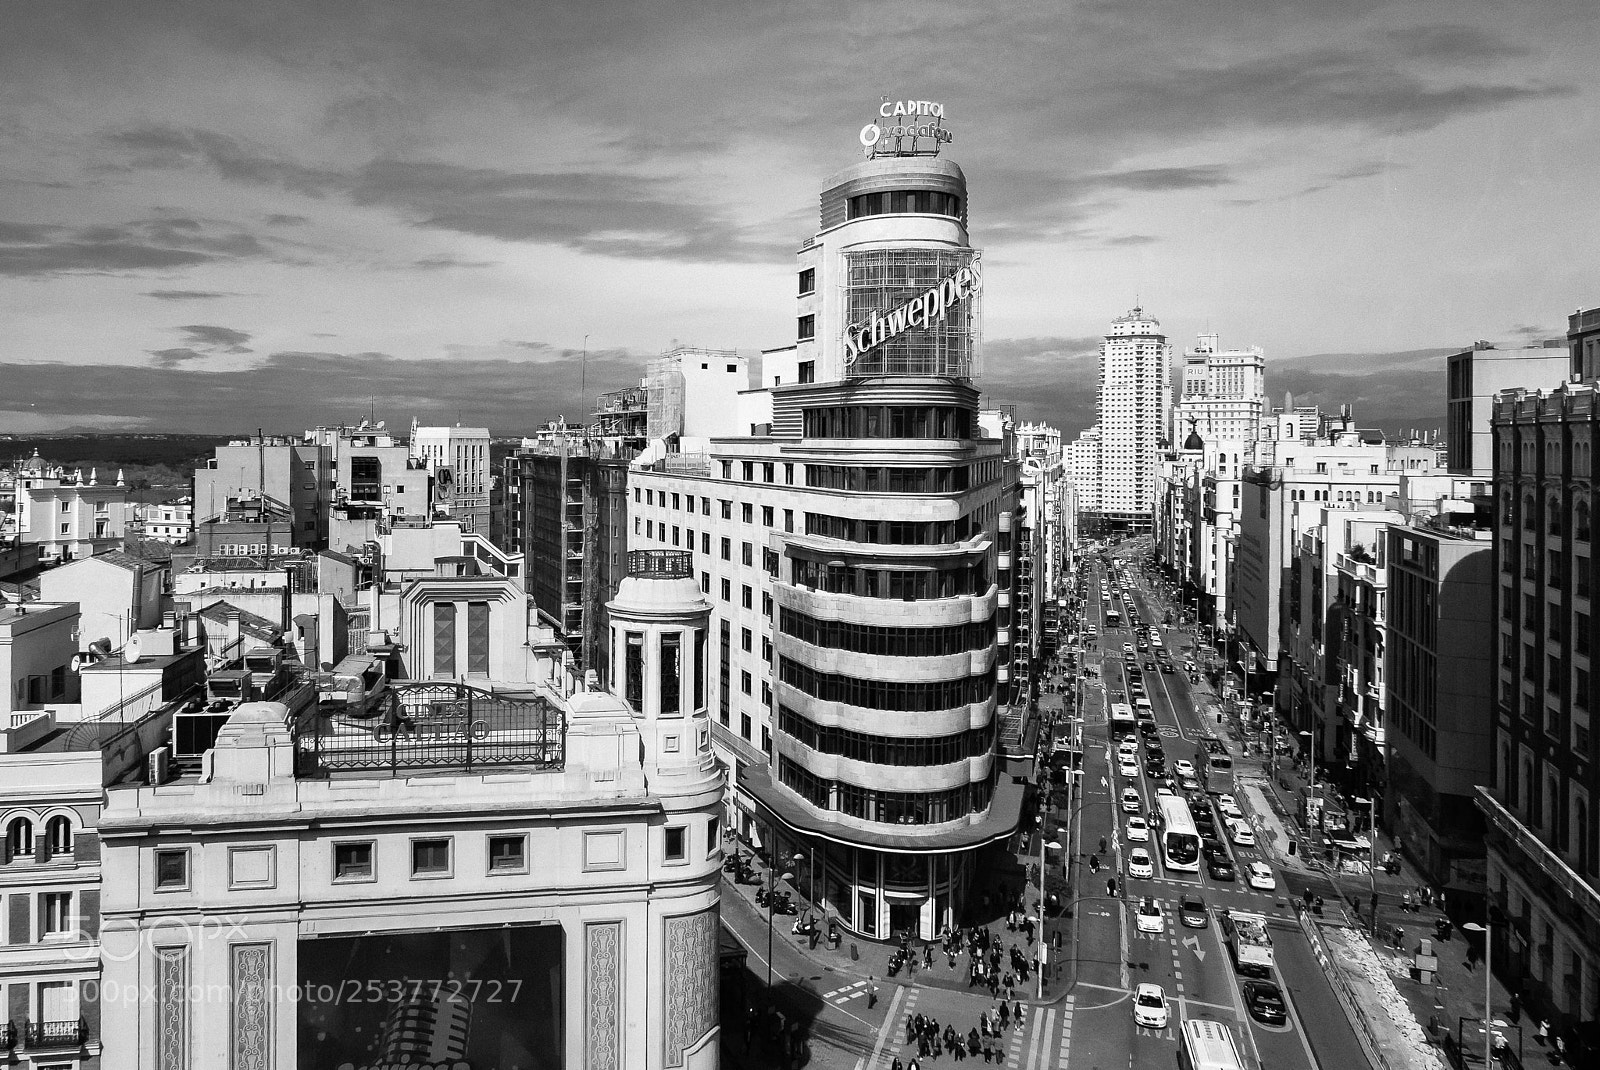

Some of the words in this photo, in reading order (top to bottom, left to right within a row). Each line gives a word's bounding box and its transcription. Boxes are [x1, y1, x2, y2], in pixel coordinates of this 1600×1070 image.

[880, 100, 944, 118] CAPITOL
[843, 254, 982, 366] Schweppes
[397, 701, 468, 719] CINES
[373, 720, 490, 743] CALLAO
[1238, 851, 1263, 860] BUS
[1135, 1025, 1176, 1041] TAXI
